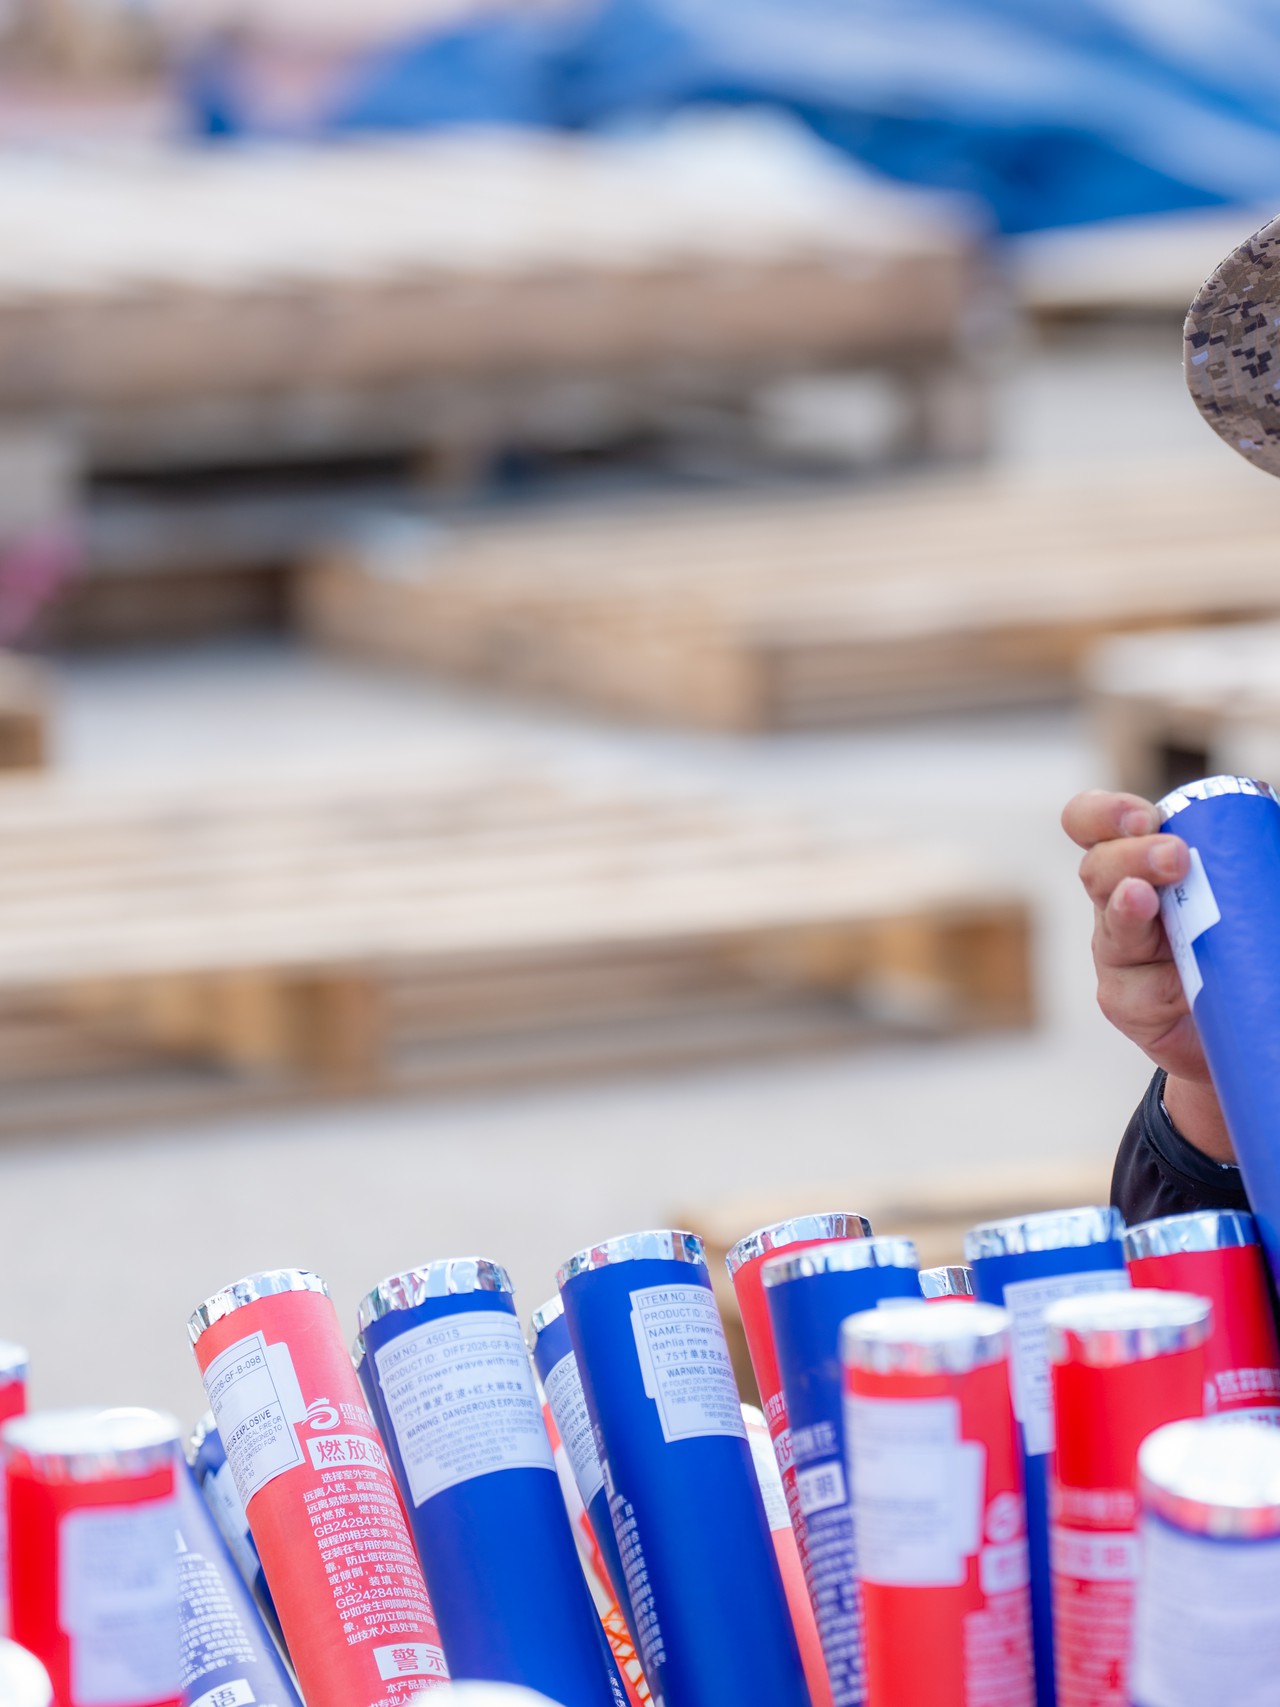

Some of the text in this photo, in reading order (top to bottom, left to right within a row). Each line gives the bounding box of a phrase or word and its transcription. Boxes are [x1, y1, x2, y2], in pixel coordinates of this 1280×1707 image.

[641, 1293, 668, 1306] ITEM
[644, 1308, 690, 1322] PRODUCT
[652, 1338, 708, 1351] dahlia mine
[385, 1355, 424, 1386] PRODUCT
[441, 1399, 496, 1421] DANGEROUS
[235, 1409, 272, 1440] EXPLOSIVE
[273, 1424, 282, 1433] TO
[263, 1435, 277, 1448] FOR
[392, 1648, 447, 1672] 警示
